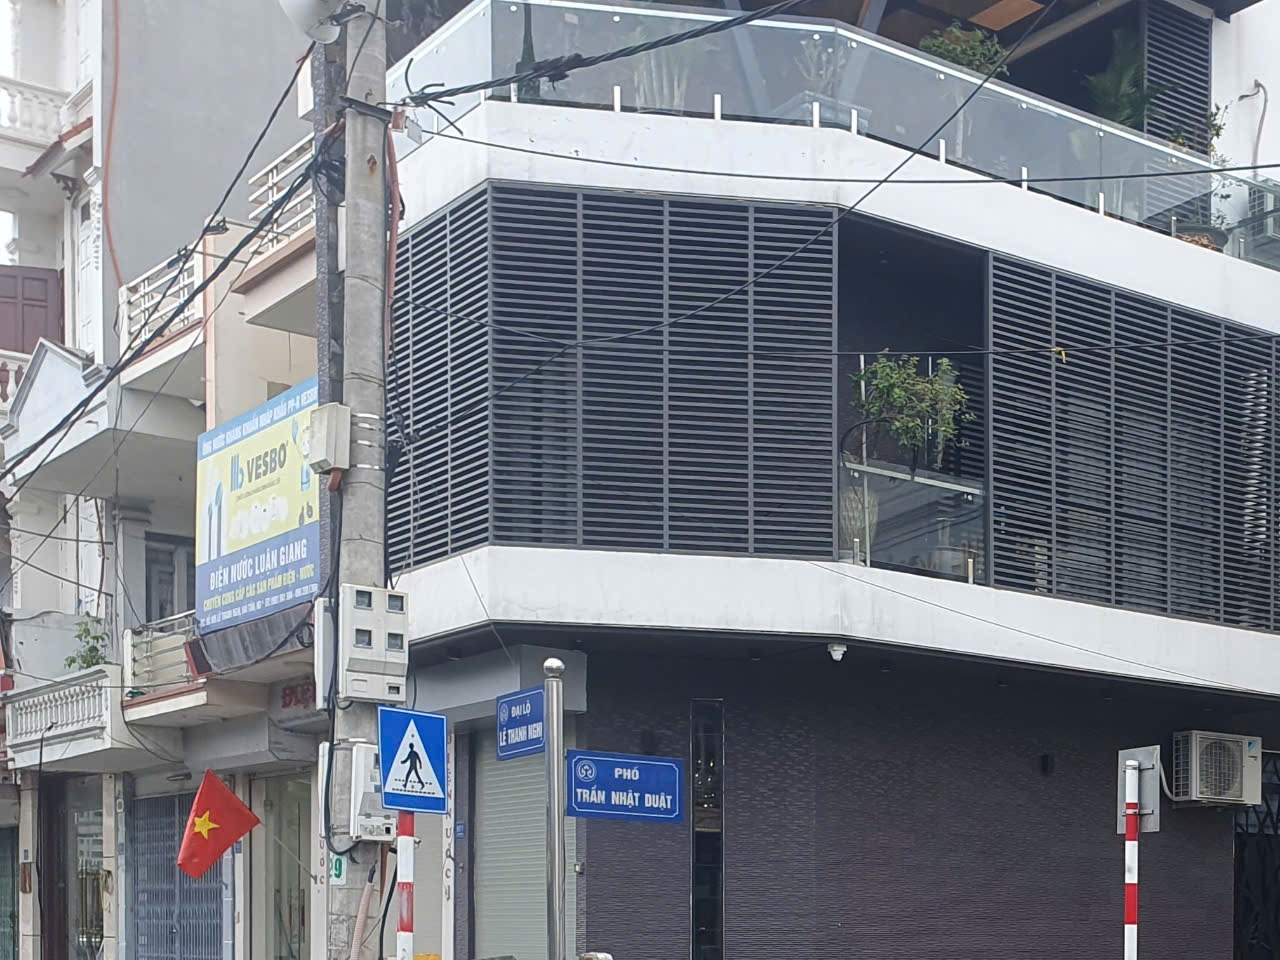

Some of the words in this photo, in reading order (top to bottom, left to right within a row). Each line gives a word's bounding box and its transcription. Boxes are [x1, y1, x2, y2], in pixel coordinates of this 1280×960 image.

[247, 443, 287, 483] VESBO
[210, 566, 229, 592] ĐIỆN
[231, 554, 253, 584] NƯỚC
[255, 548, 277, 575] LUẬN
[279, 539, 307, 565] GIANG
[511, 704, 523, 719] ĐẠI
[523, 700, 531, 717] LỘ
[500, 727, 507, 746] LÊ
[507, 725, 527, 745] THANH
[528, 721, 543, 740] NGHỊ
[614, 766, 640, 780] PHỐ
[576, 785, 605, 804] TRẦN
[611, 789, 640, 808] NHẬT
[644, 792, 672, 811] DUẬT
